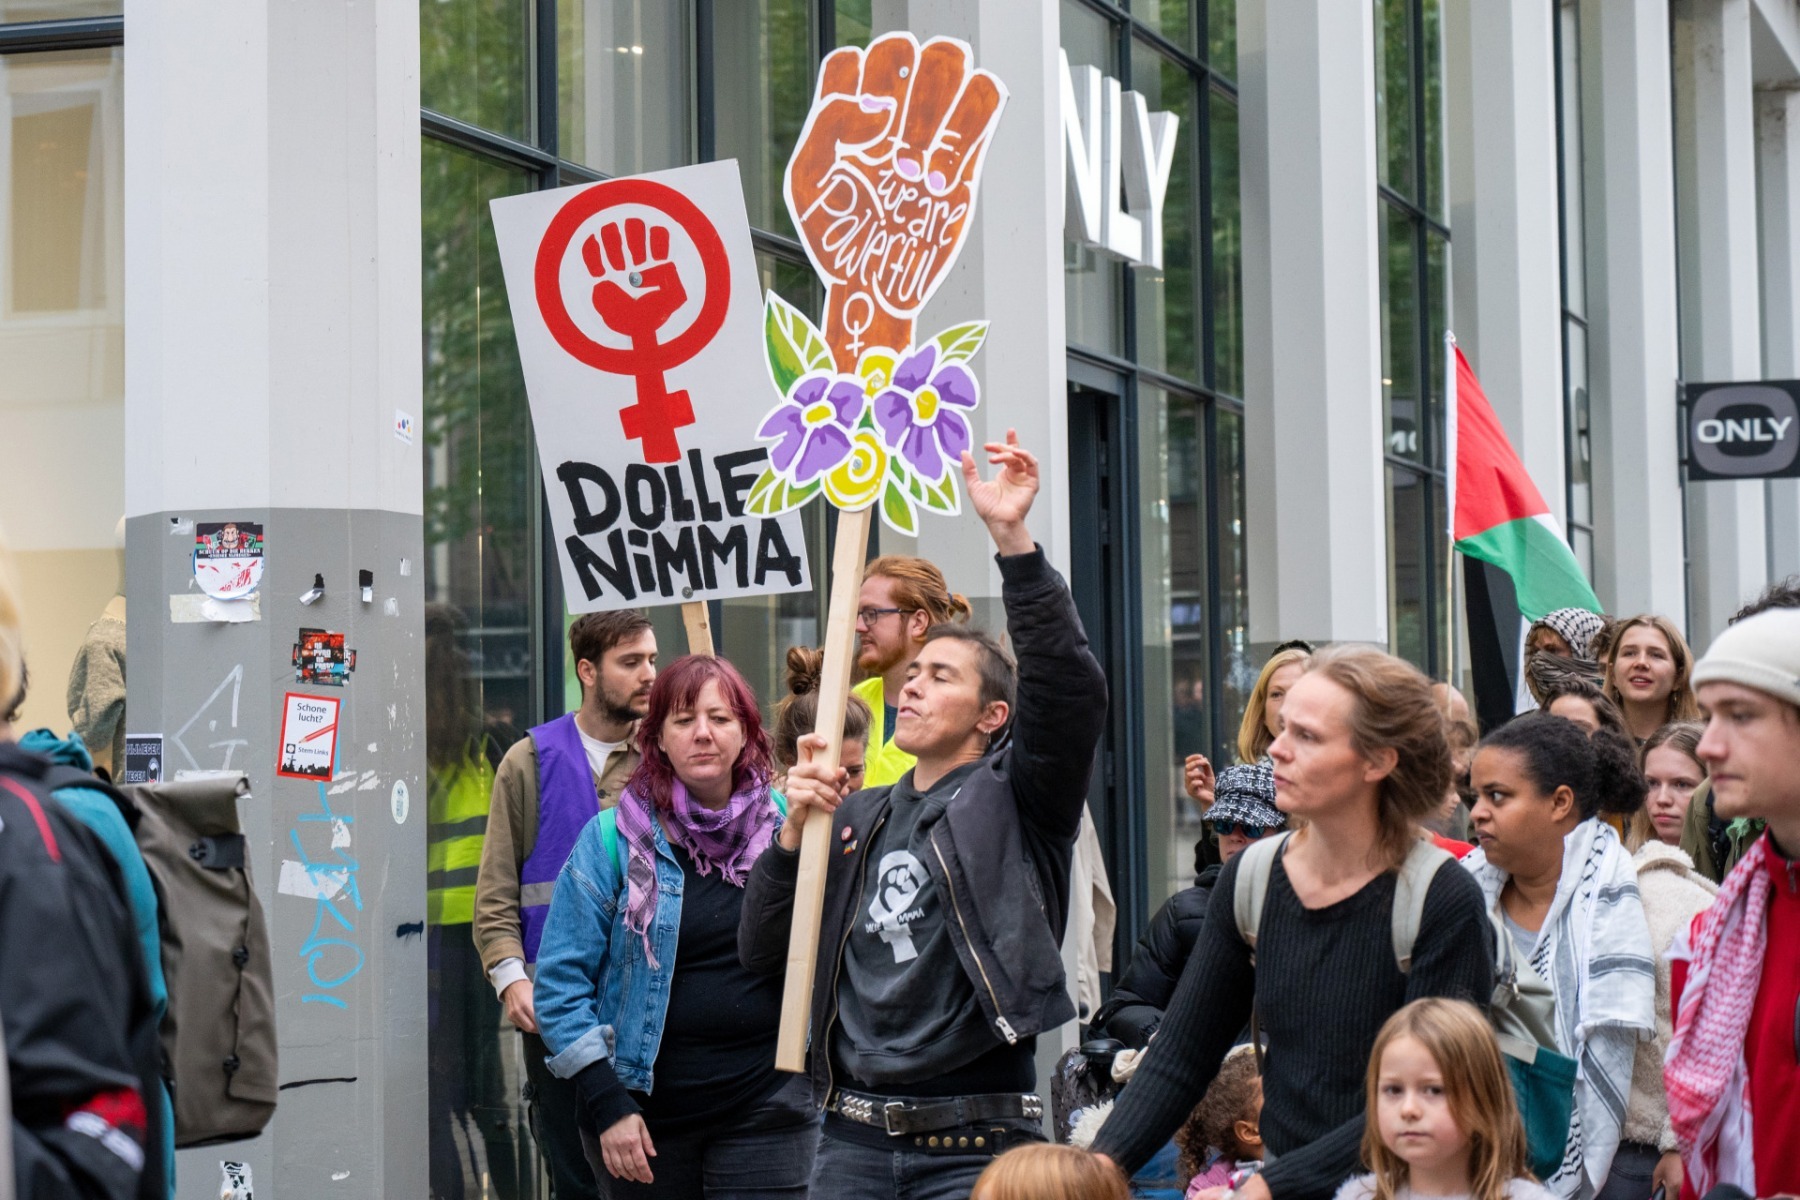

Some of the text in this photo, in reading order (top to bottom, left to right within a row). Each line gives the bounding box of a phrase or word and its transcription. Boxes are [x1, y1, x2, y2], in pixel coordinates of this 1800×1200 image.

[1060, 47, 1180, 271] NLY
[800, 173, 938, 303] Powerful
[907, 197, 968, 248] are
[1696, 416, 1793, 444] ONLY
[556, 447, 769, 536] DOLLE
[297, 702, 327, 713] Schone
[298, 713, 323, 723] lucht?
[314, 747, 329, 756] Links
